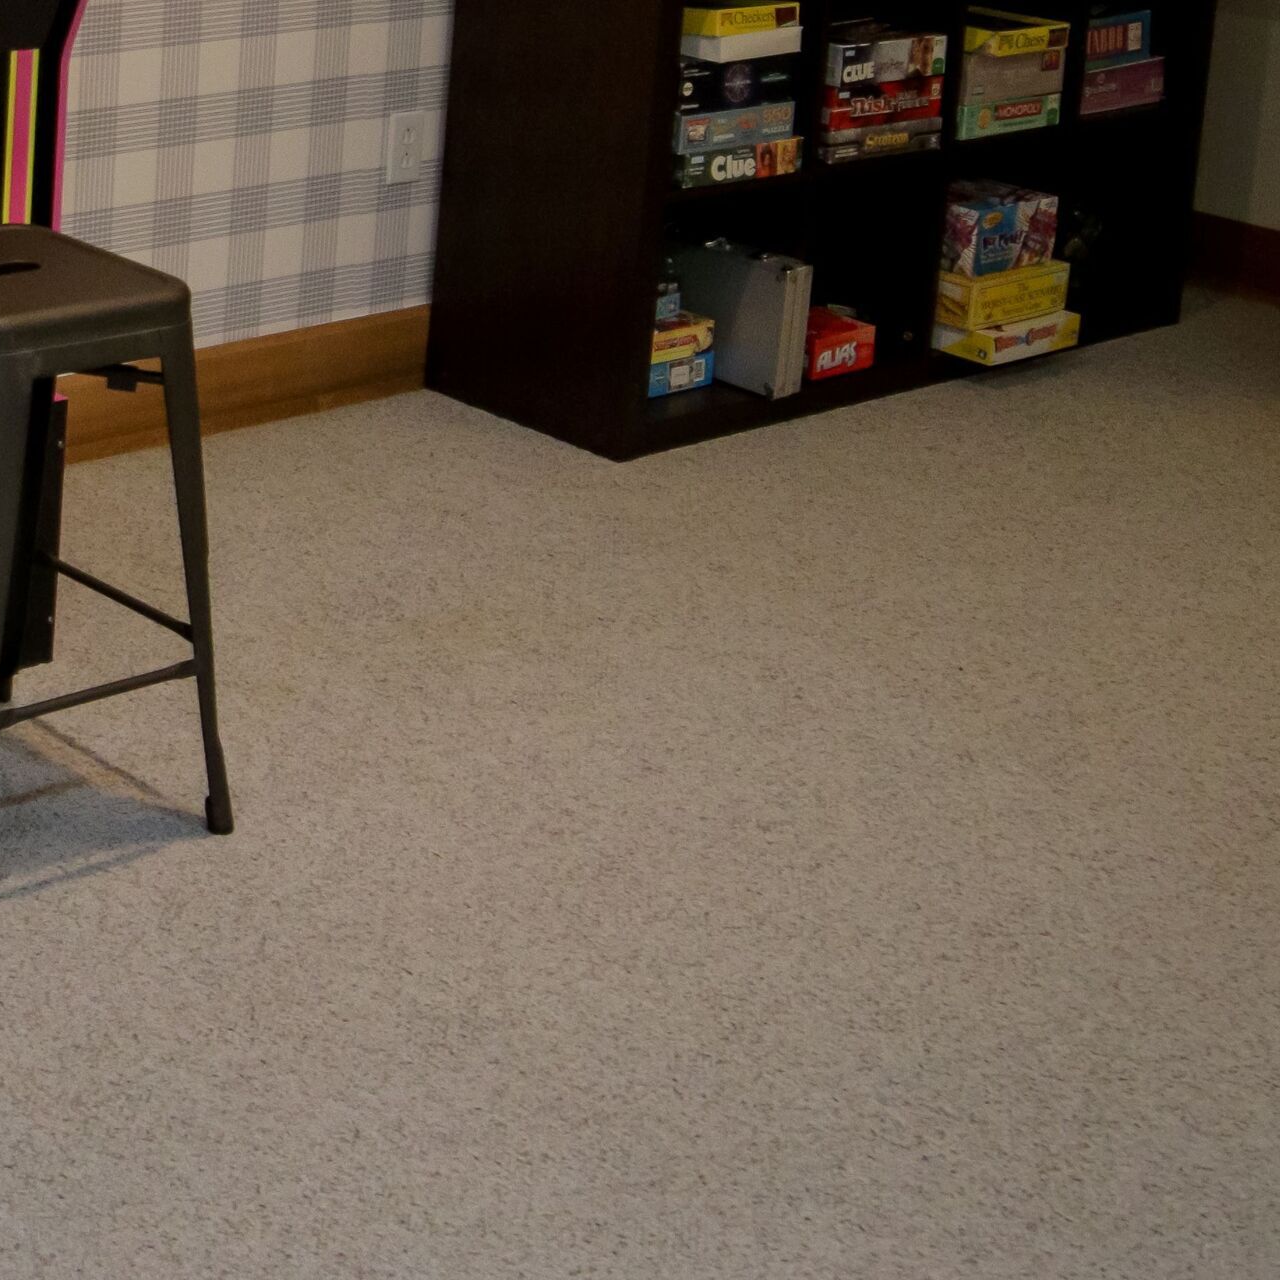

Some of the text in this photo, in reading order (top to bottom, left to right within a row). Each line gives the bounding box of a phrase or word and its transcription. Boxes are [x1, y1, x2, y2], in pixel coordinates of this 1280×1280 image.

[734, 9, 775, 26] Checkers
[1014, 32, 1047, 48] Chess
[842, 61, 875, 83] CLUE
[996, 101, 1042, 118] MONOPOLY
[710, 154, 757, 182] Clue
[815, 338, 859, 373] ALIAS
